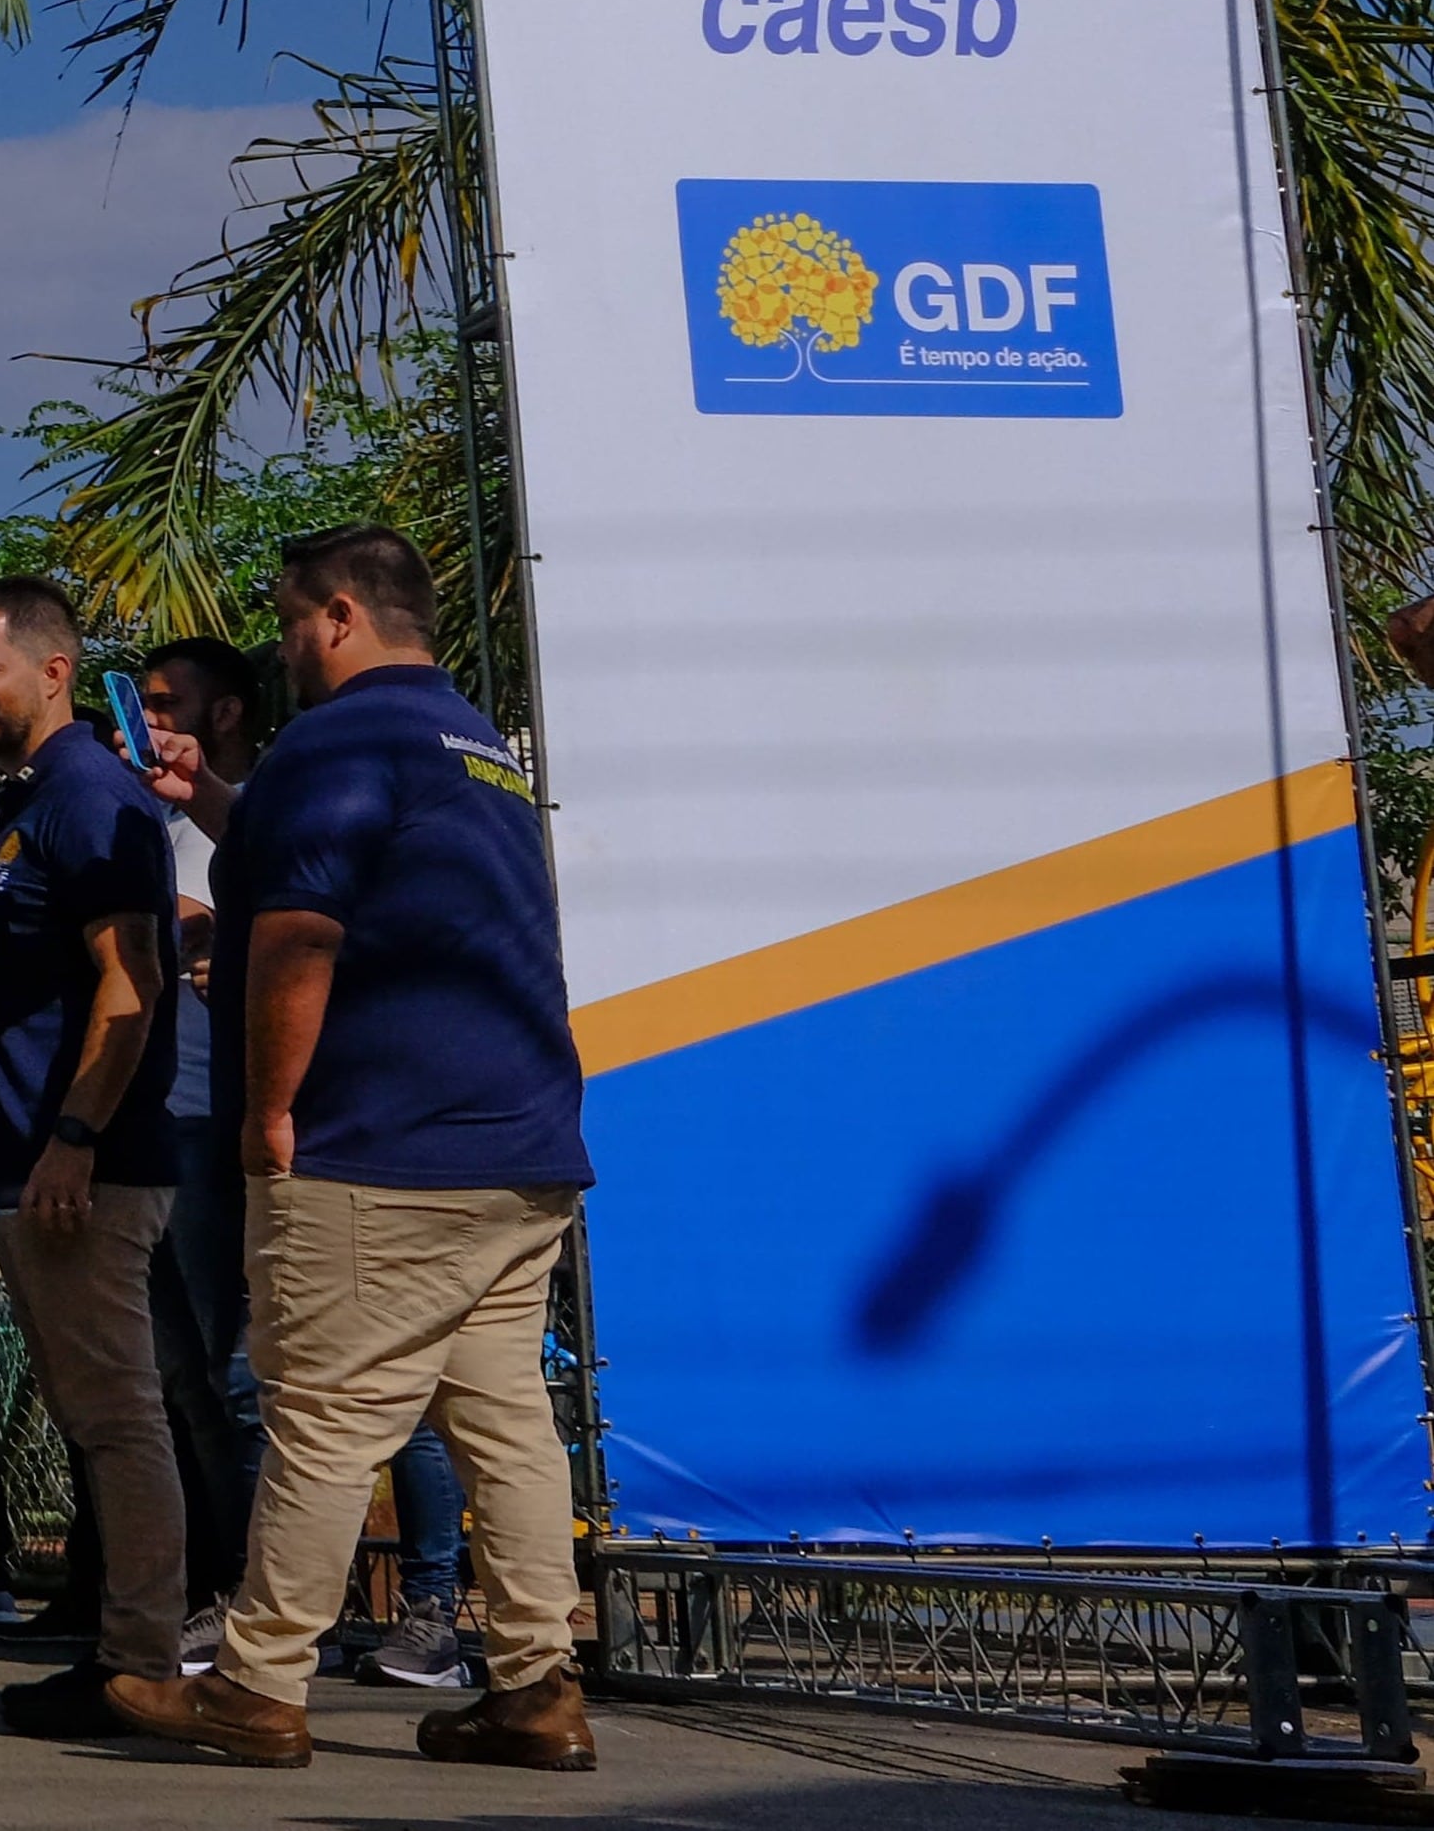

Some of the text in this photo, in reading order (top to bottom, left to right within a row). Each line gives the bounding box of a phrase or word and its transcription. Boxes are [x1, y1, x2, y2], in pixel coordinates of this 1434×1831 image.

[894, 262, 1076, 332] GDF
[900, 340, 1087, 372] É tempo de ação.
